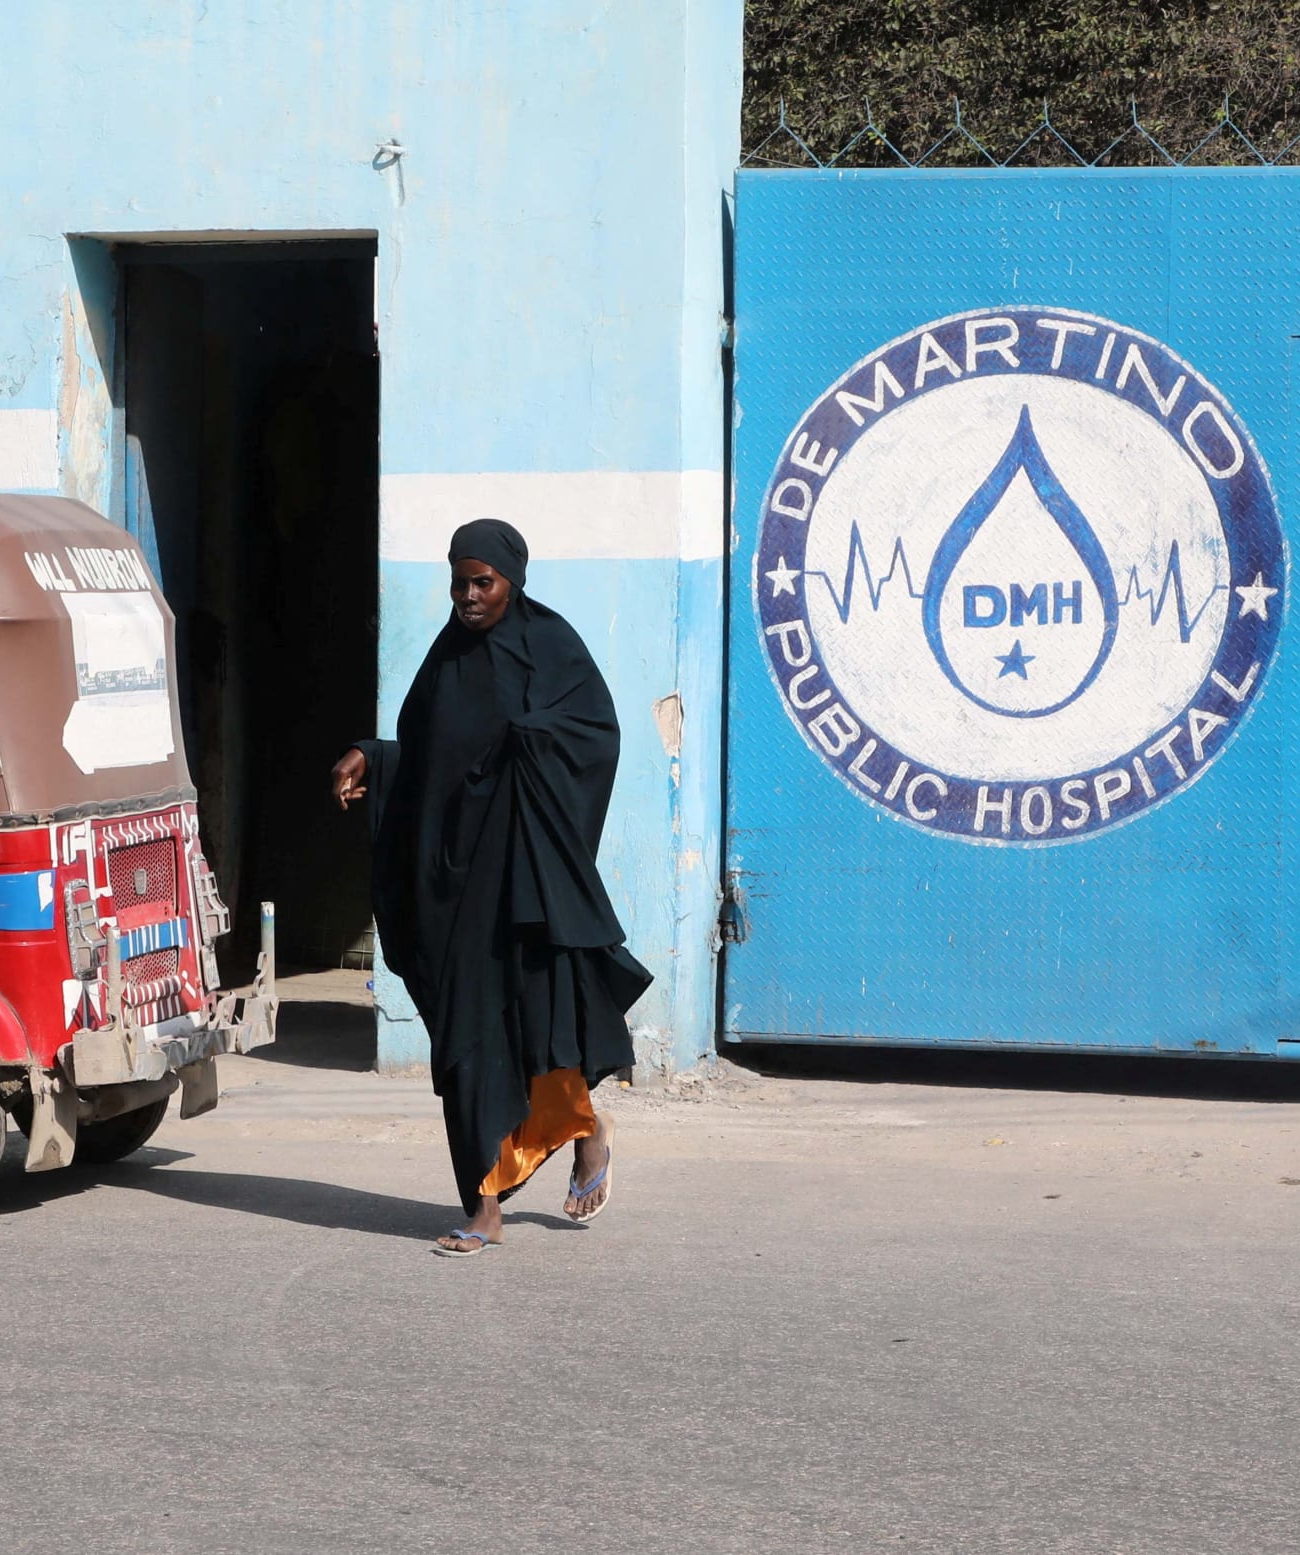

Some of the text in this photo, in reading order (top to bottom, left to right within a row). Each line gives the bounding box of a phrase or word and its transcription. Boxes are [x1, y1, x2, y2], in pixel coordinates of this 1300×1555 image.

[770, 318, 1245, 521] DE MARTINO
[963, 582, 1083, 628] DMH
[765, 620, 1259, 834] PUBLIC HOSPITAL
